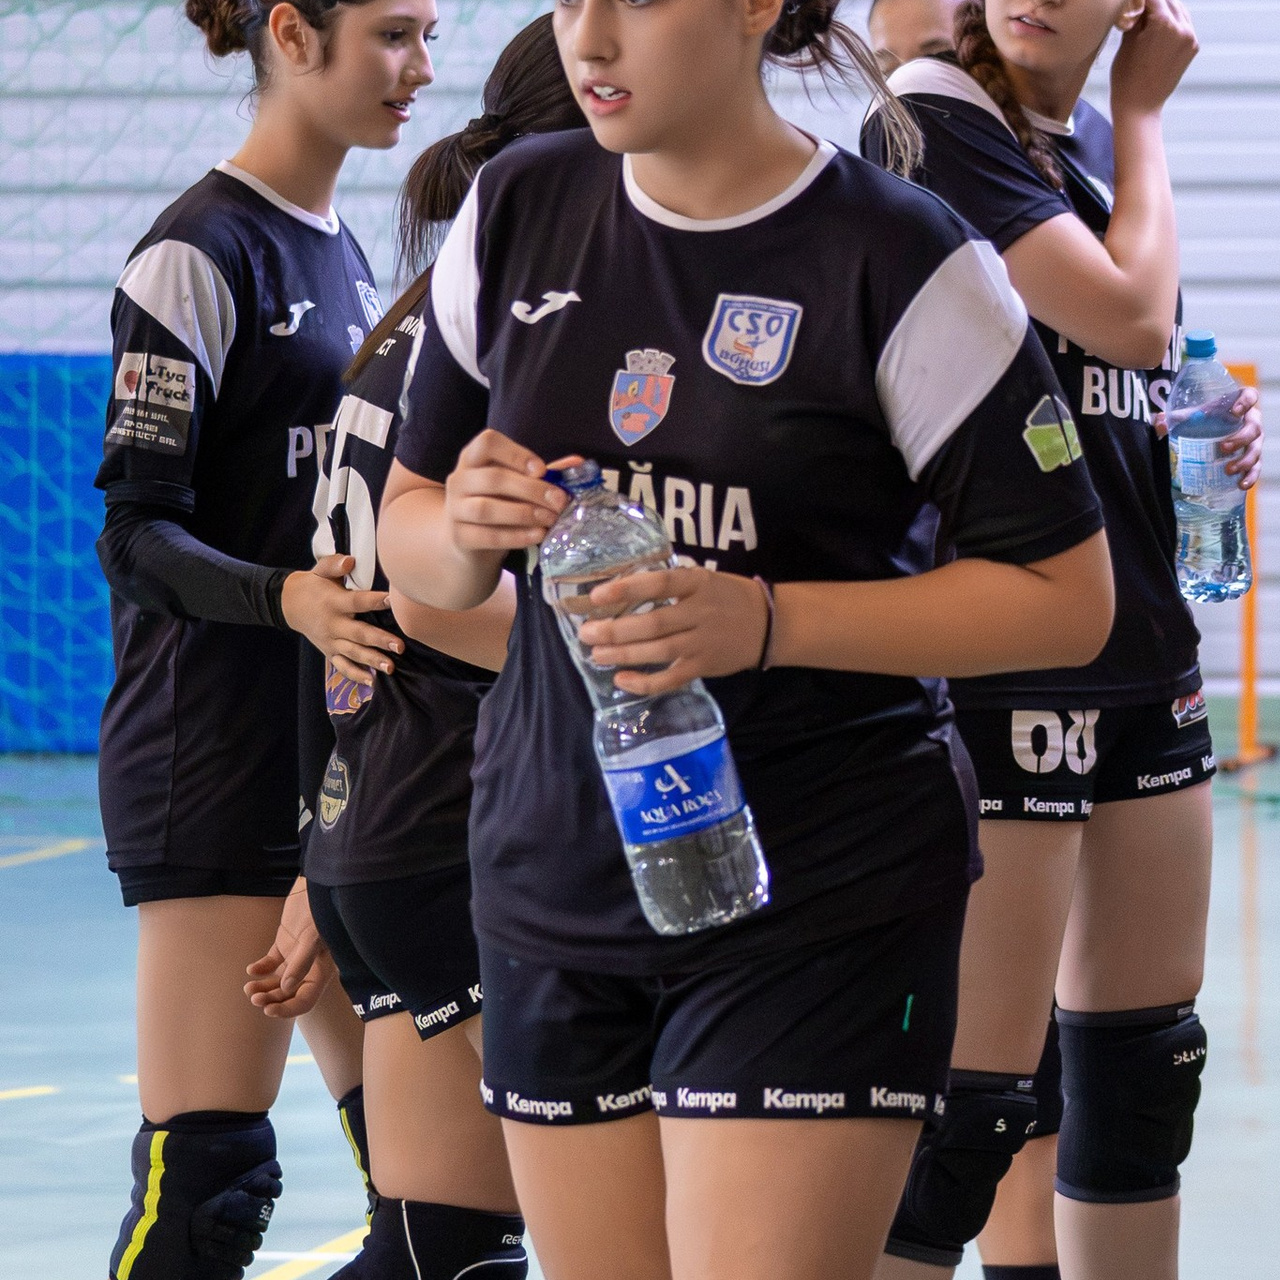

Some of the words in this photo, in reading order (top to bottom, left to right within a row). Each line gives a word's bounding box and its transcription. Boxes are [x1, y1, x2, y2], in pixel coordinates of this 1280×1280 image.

[728, 310, 784, 337] CSO
[1137, 767, 1193, 790] Kempa
[1023, 797, 1075, 817] Kempa
[414, 1000, 460, 1031] Kempa
[506, 1091, 573, 1120] Kempa
[677, 1087, 737, 1113] Kempa
[763, 1087, 846, 1114] Kempa
[870, 1086, 927, 1114] Kempa
